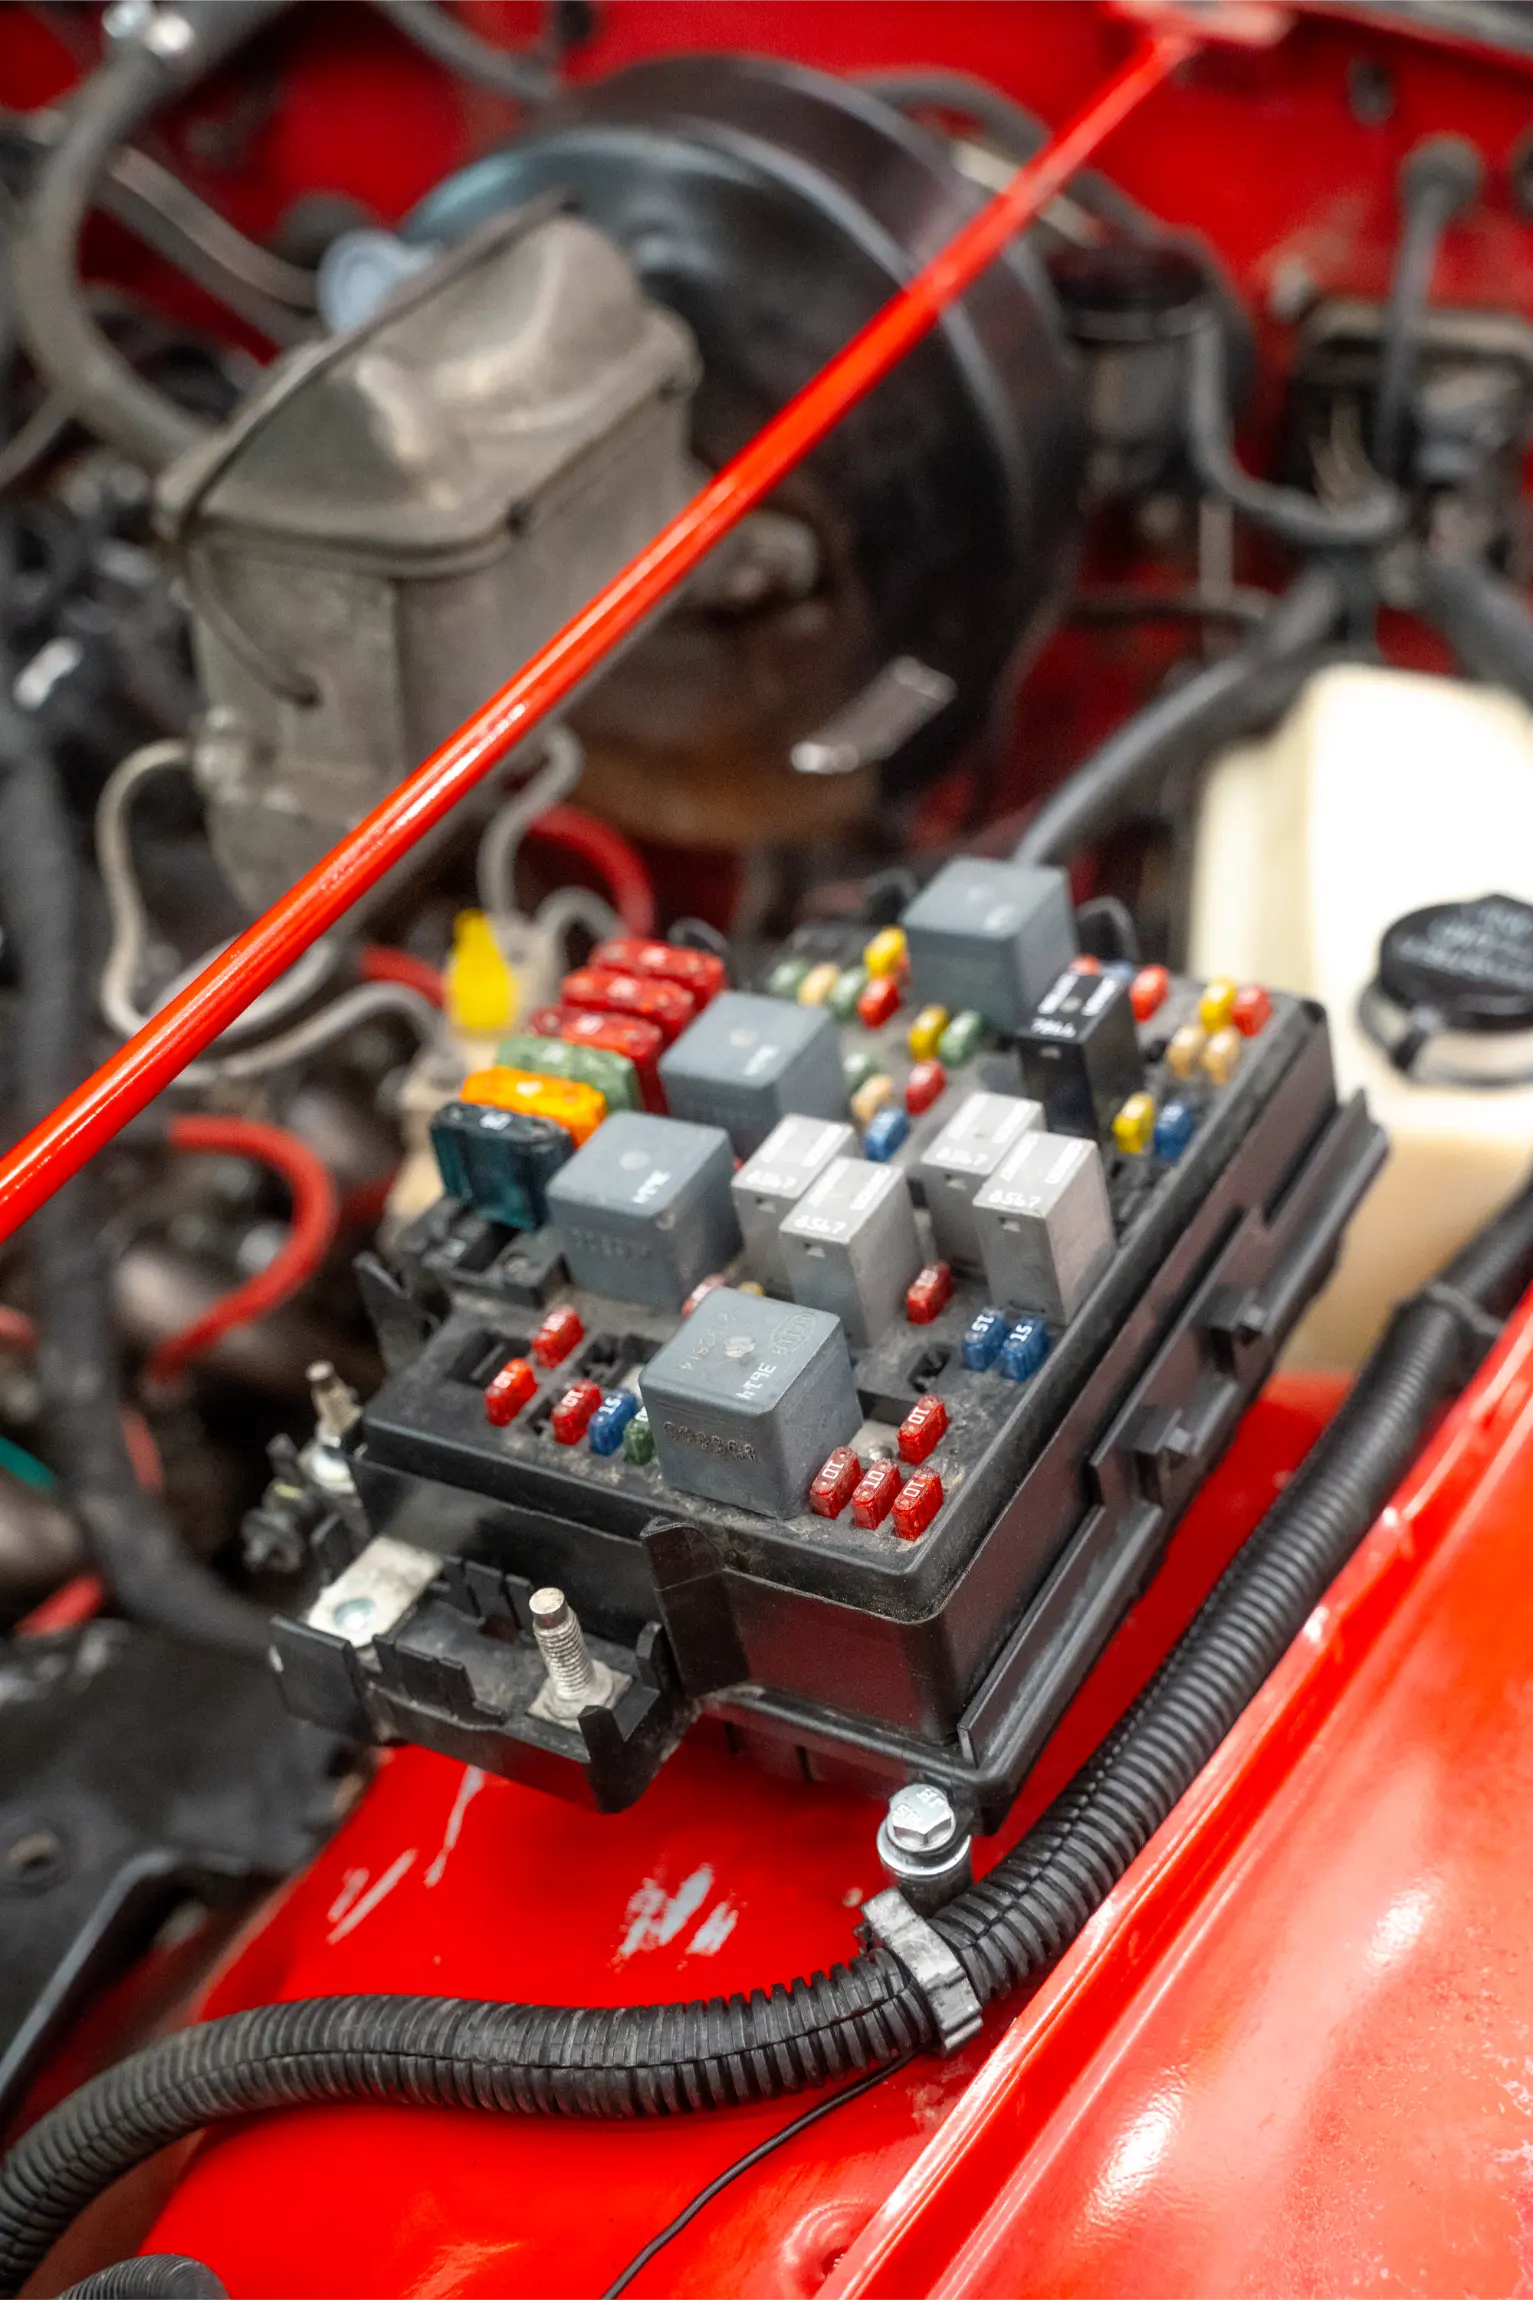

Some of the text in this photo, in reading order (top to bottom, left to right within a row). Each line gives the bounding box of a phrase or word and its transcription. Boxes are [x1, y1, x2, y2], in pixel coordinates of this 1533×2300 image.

[971, 1313, 995, 1333] 15
[1009, 1323, 1033, 1343] 15
[736, 1362, 777, 1400] 3614
[599, 1397, 622, 1415] 15
[907, 1405, 930, 1425] 10
[821, 1459, 845, 1480] 10
[861, 1469, 886, 1490] 10
[902, 1481, 926, 1498] 10
